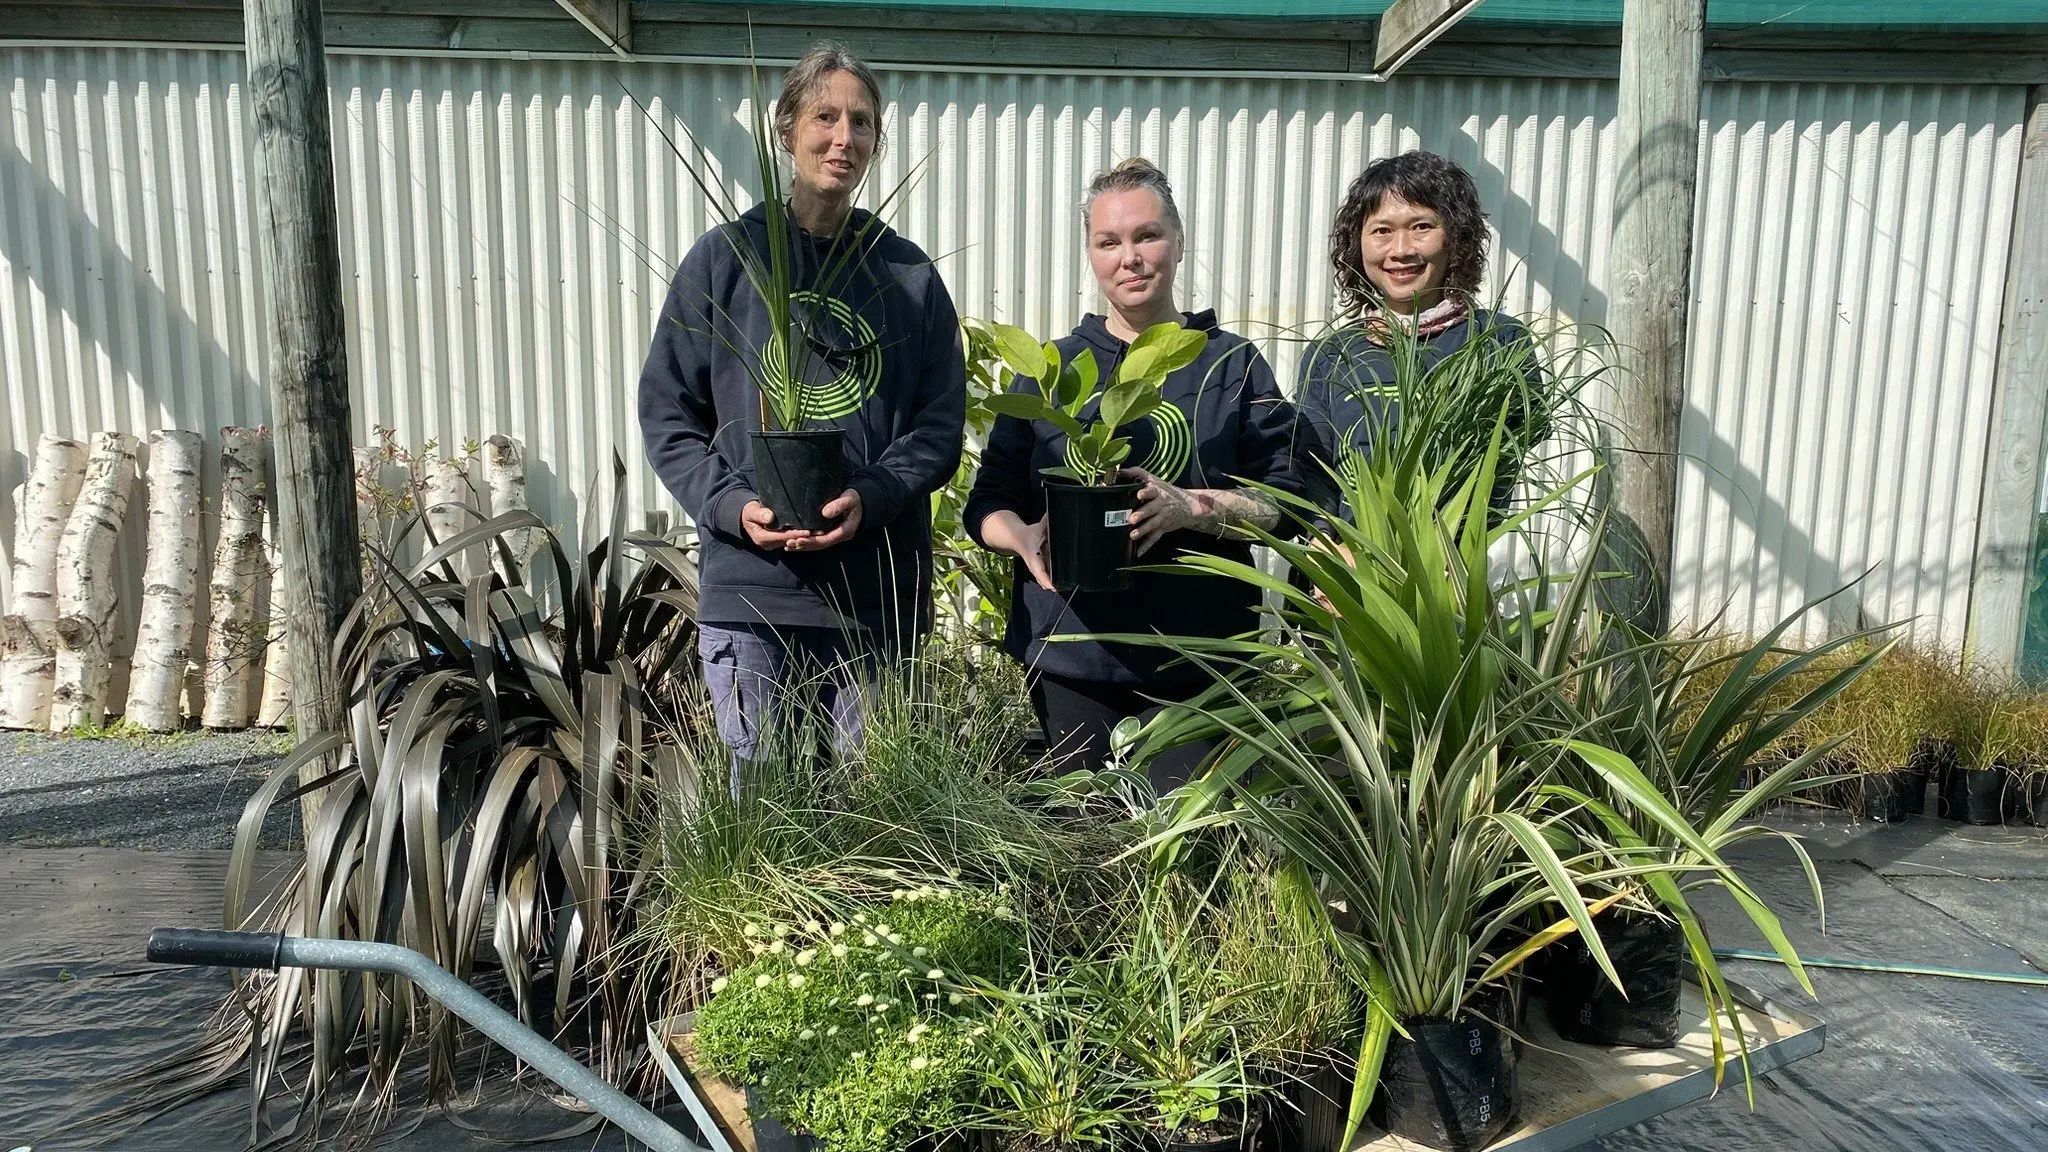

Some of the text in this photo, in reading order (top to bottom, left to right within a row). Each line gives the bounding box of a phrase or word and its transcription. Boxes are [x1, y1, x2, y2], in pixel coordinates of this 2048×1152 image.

[1579, 940, 1591, 965] B5
[1580, 1002, 1592, 1026] PB5
[1468, 1028, 1482, 1056] PB5
[1479, 1094, 1491, 1123] PB5
